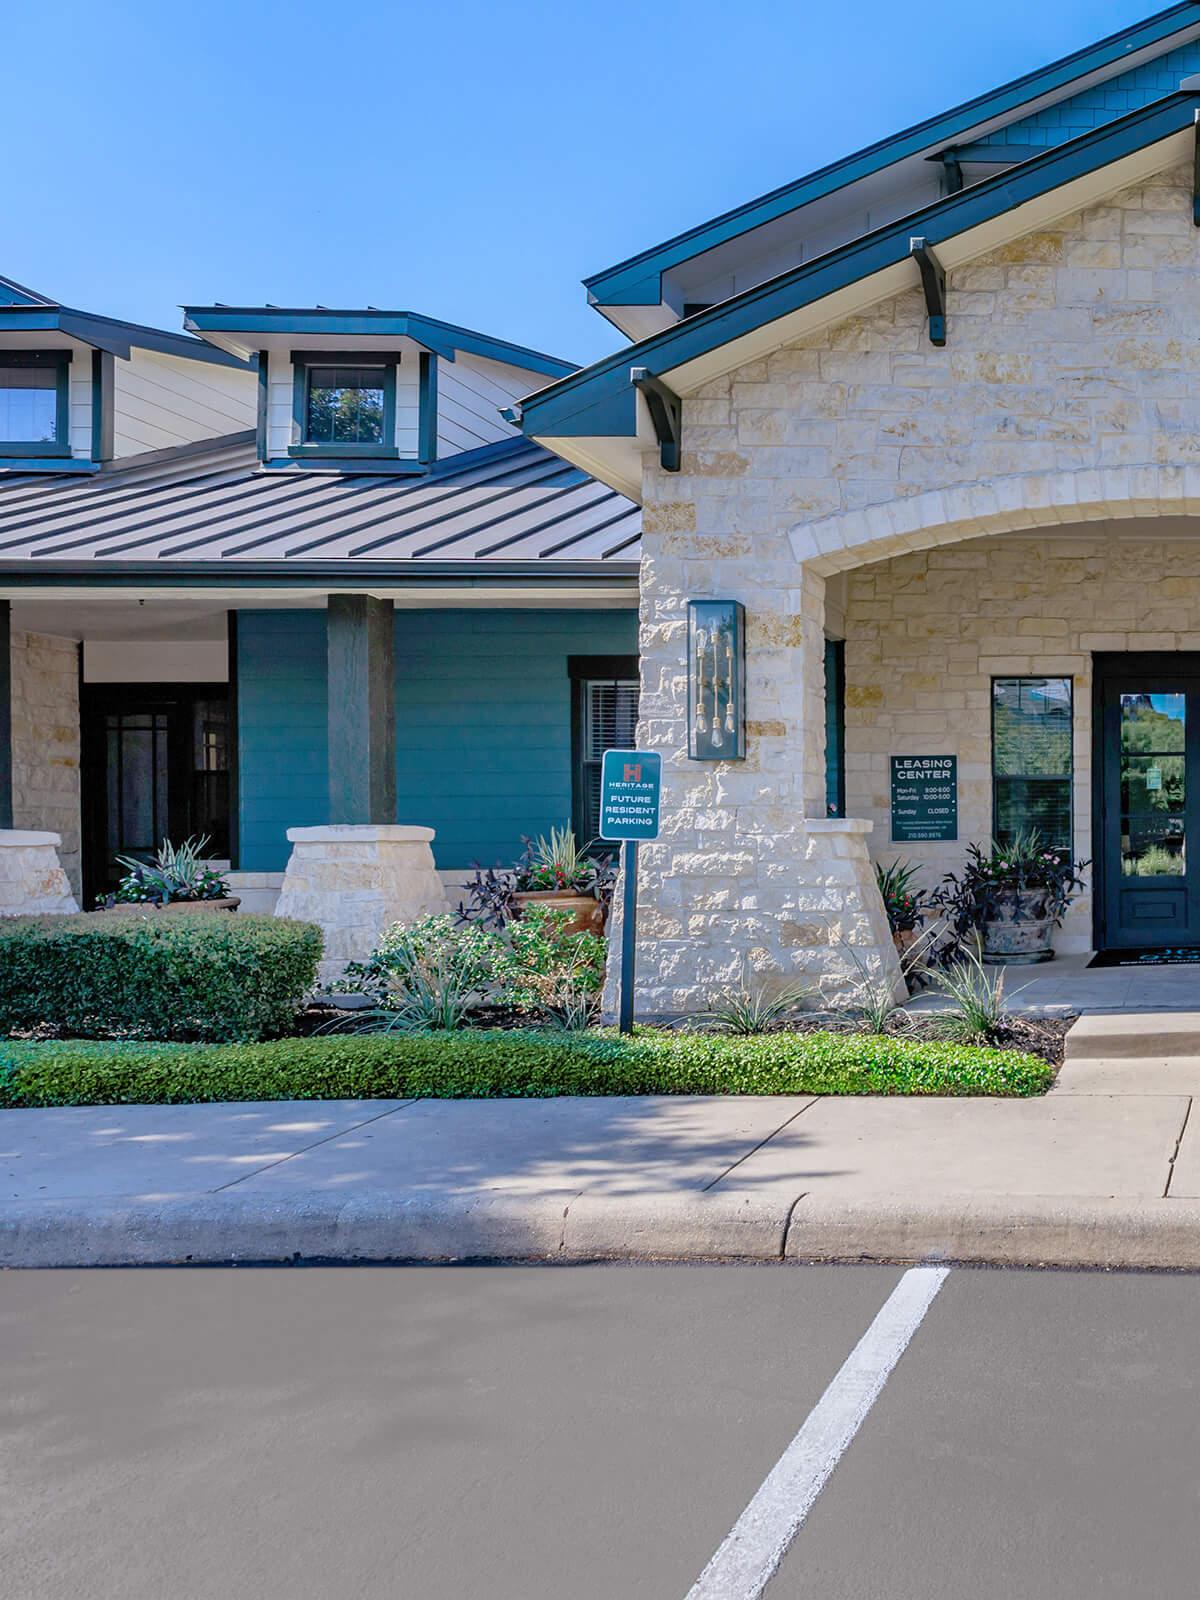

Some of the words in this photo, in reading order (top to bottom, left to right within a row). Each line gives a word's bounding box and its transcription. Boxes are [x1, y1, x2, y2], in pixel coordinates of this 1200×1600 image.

[895, 760, 953, 769] LEASING
[897, 770, 951, 779] CENTER
[608, 781, 654, 789] HERITAGE
[610, 795, 652, 804] FUTURE
[605, 805, 656, 815] RESIDENT
[607, 817, 653, 826] PARKING
